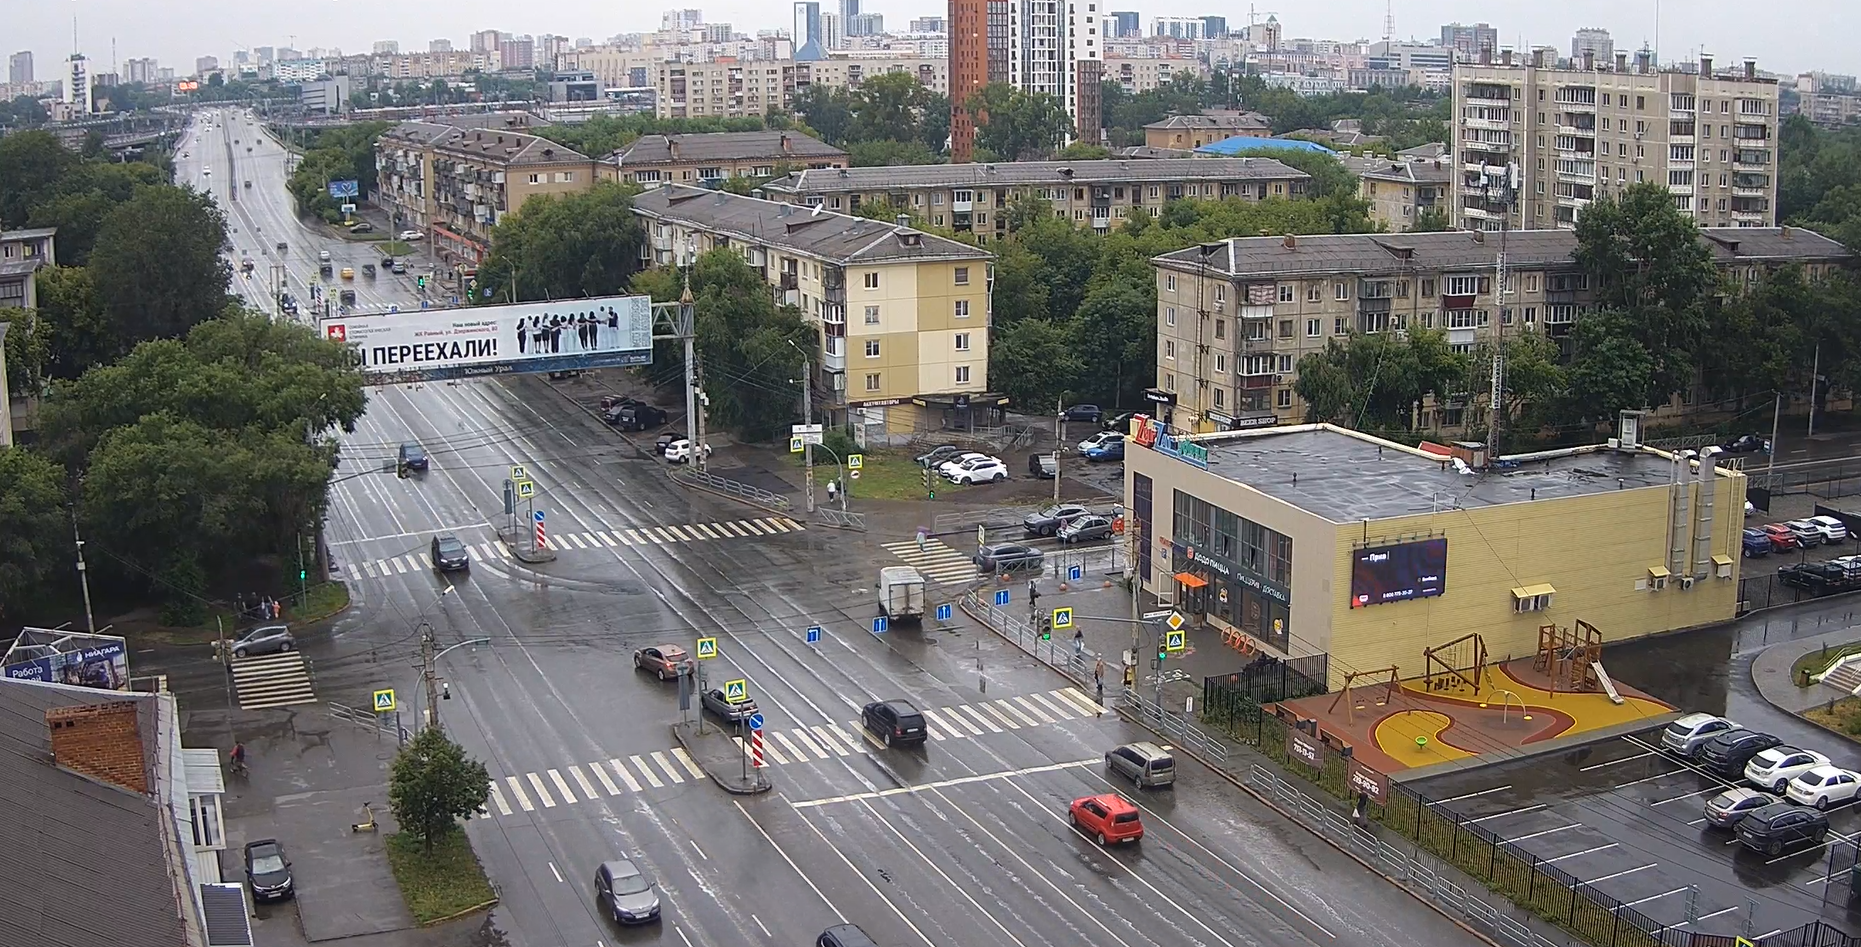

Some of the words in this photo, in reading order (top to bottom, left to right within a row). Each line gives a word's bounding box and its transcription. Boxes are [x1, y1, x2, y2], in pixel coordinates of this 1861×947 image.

[373, 338, 498, 365] ПЕРЕЕХАЛИ!
[464, 366, 493, 375] Южный
[495, 365, 513, 373] Урал
[1240, 419, 1258, 427] BEER
[1258, 417, 1276, 425] SHOP
[1194, 552, 1210, 566] ДОДО
[1210, 559, 1230, 575] ПИЦЦА
[1262, 584, 1286, 602] ДОСТАВКА
[84, 645, 120, 659] НИАГАРА
[12, 666, 43, 679] Работа
